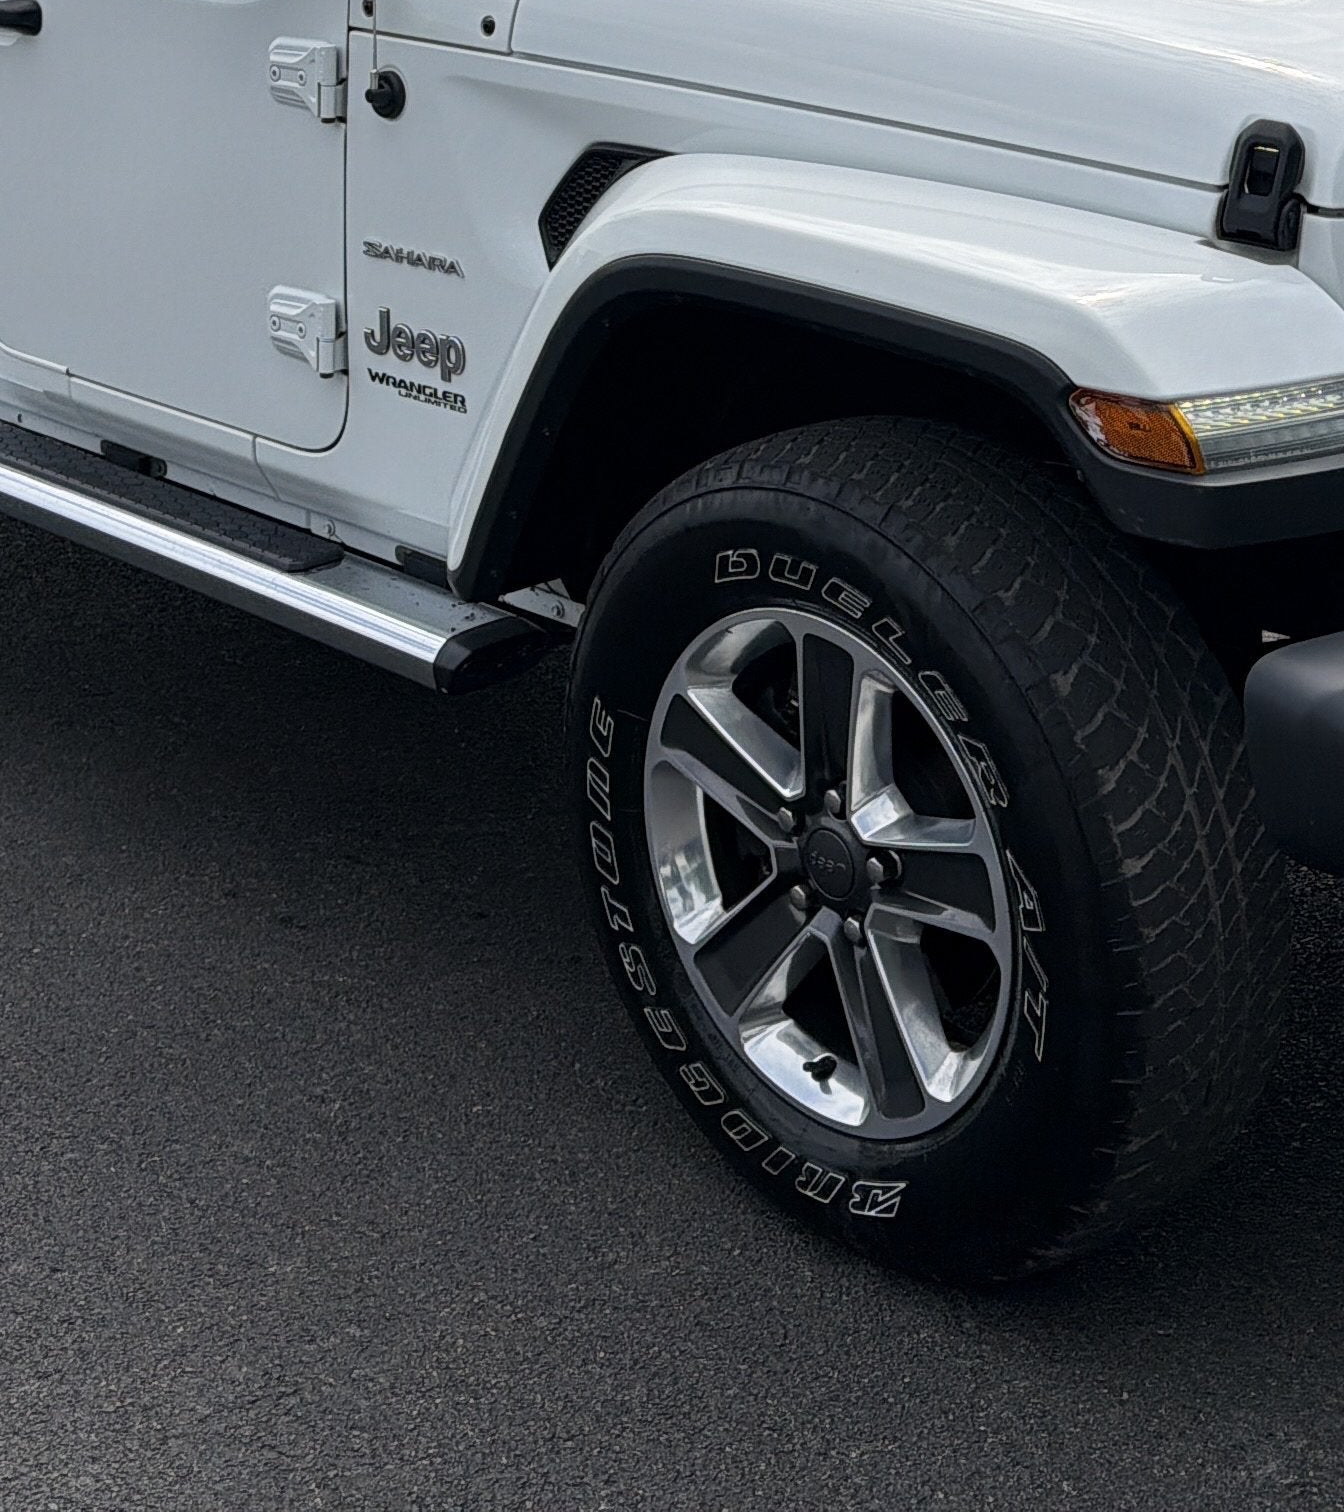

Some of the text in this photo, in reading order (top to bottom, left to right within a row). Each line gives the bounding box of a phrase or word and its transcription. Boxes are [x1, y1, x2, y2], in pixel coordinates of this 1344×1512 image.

[363, 240, 465, 279] SAHARA
[363, 306, 466, 383] Jeep
[367, 368, 467, 408] WRANGLER
[398, 389, 467, 414] UNLIMITED
[714, 548, 1009, 808] DUELER
[587, 698, 909, 1217] BRIDGESTONE
